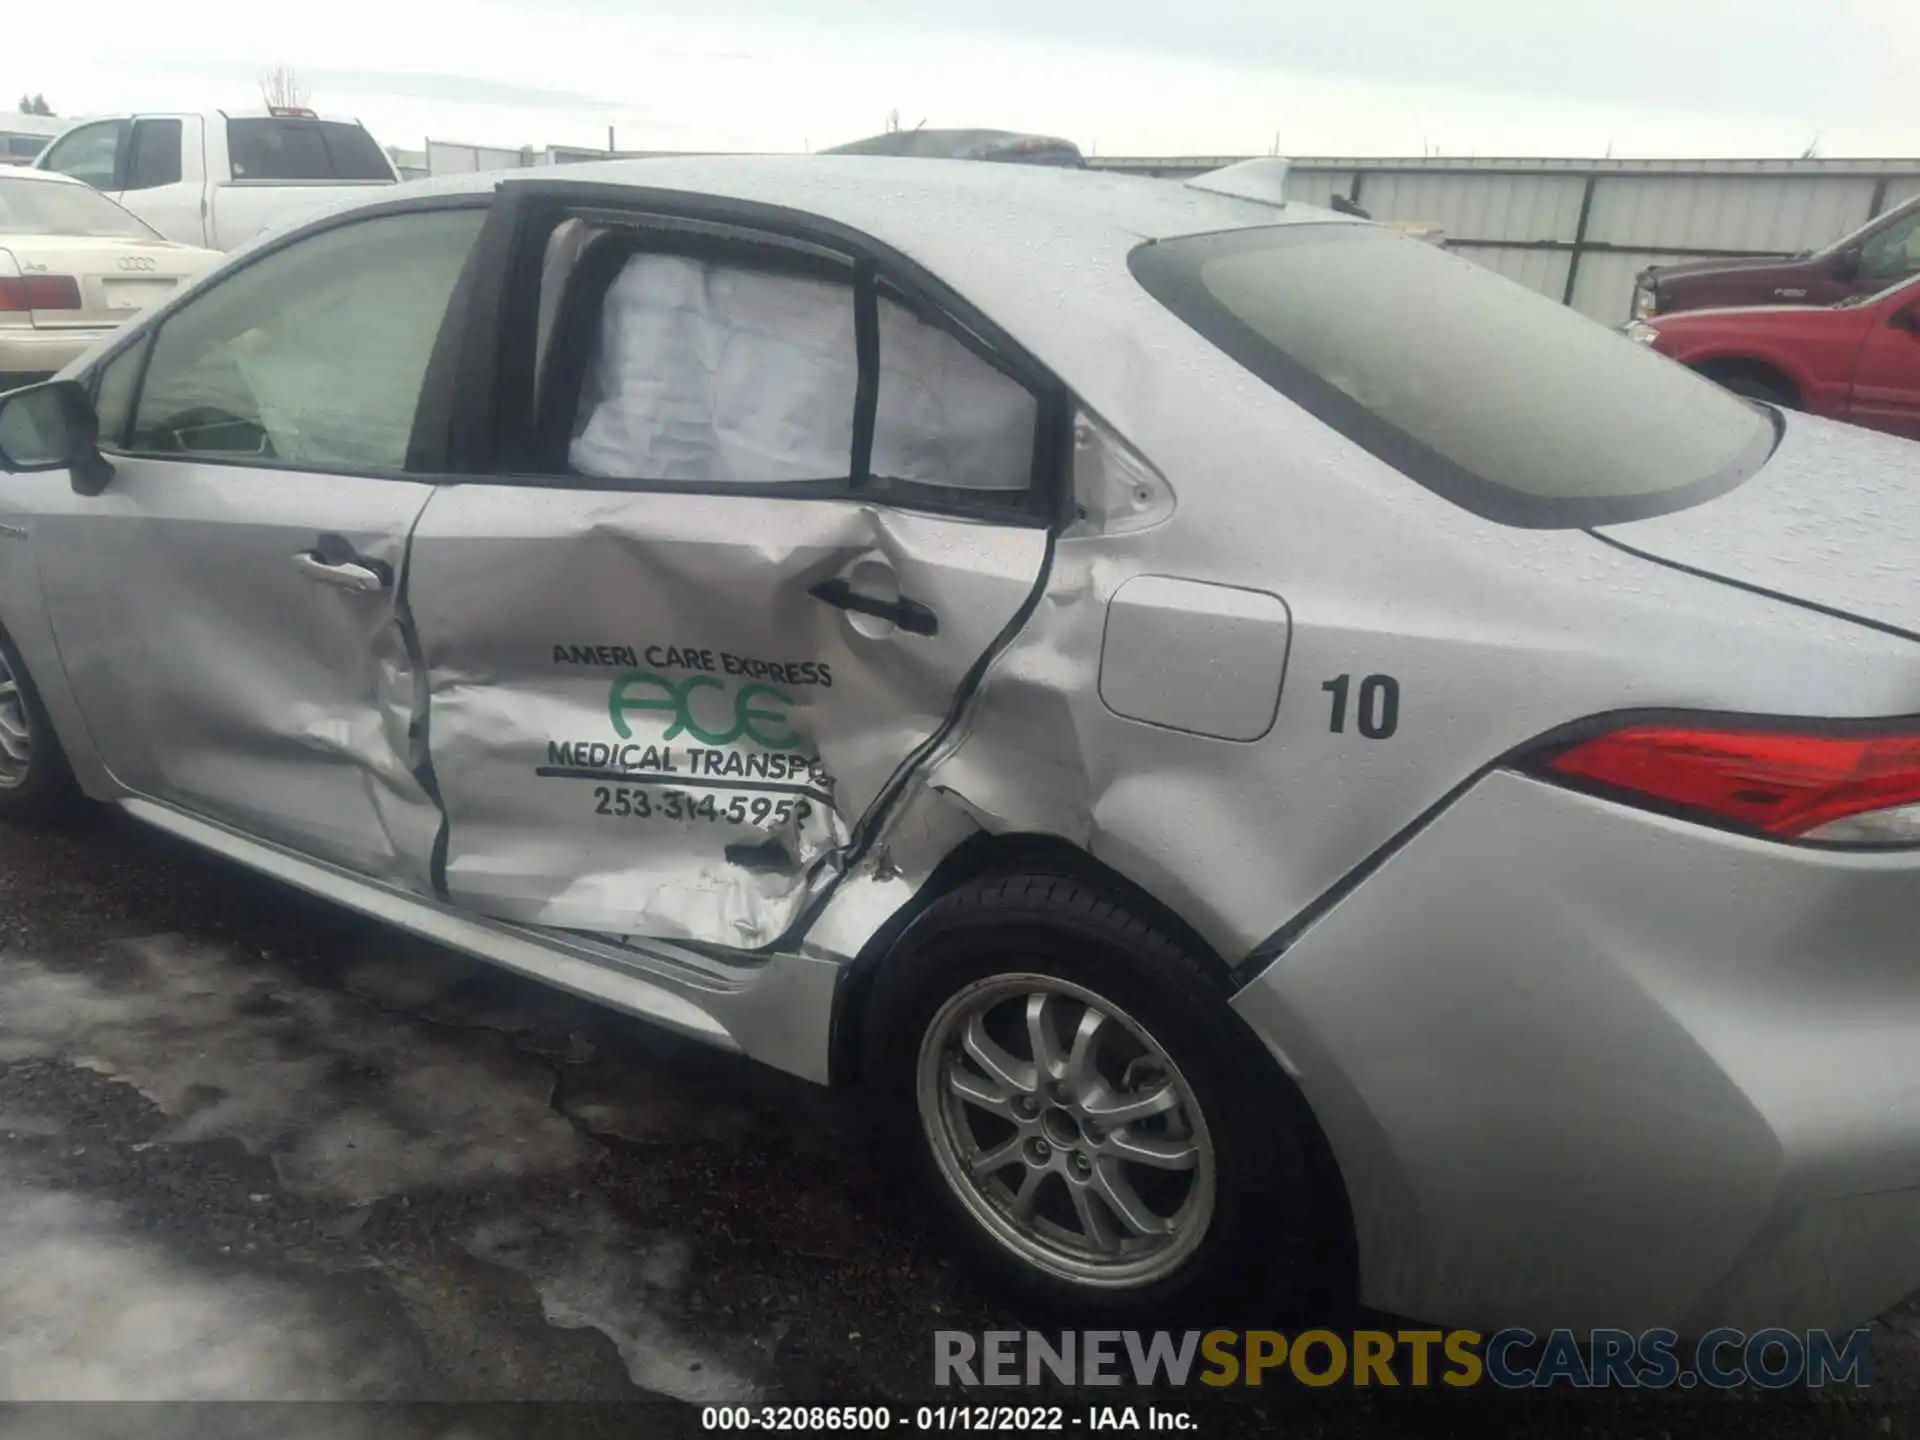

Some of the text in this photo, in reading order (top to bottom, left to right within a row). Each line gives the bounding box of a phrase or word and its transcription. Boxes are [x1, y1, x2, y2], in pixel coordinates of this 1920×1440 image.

[553, 645, 832, 687] AMERI CARE EXPRESS
[609, 672, 800, 750] ACE
[1321, 674, 1399, 740] 10
[548, 741, 677, 773] MEDICAL
